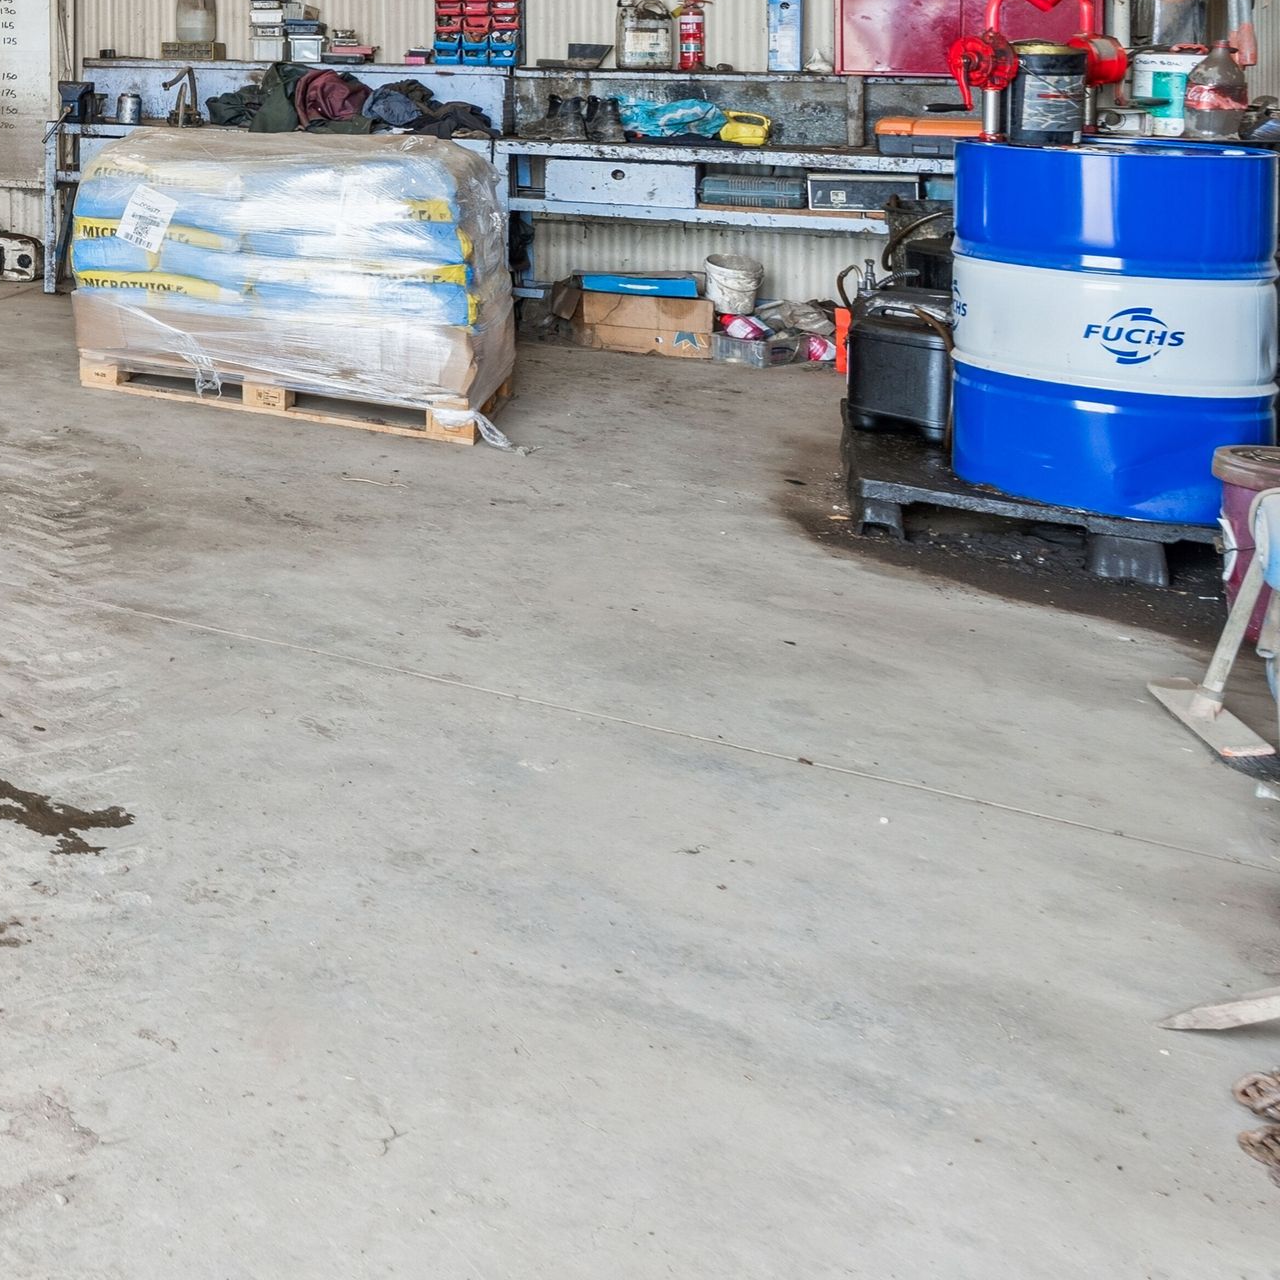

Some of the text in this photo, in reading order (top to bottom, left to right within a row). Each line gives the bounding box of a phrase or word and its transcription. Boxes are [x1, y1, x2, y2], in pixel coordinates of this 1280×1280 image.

[0, 7, 16, 16] 130
[2, 72, 17, 81] 150
[1, 88, 17, 99] 175
[1, 106, 18, 115] 150
[952, 298, 968, 317] CHS
[1083, 323, 1186, 347] FUCHS
